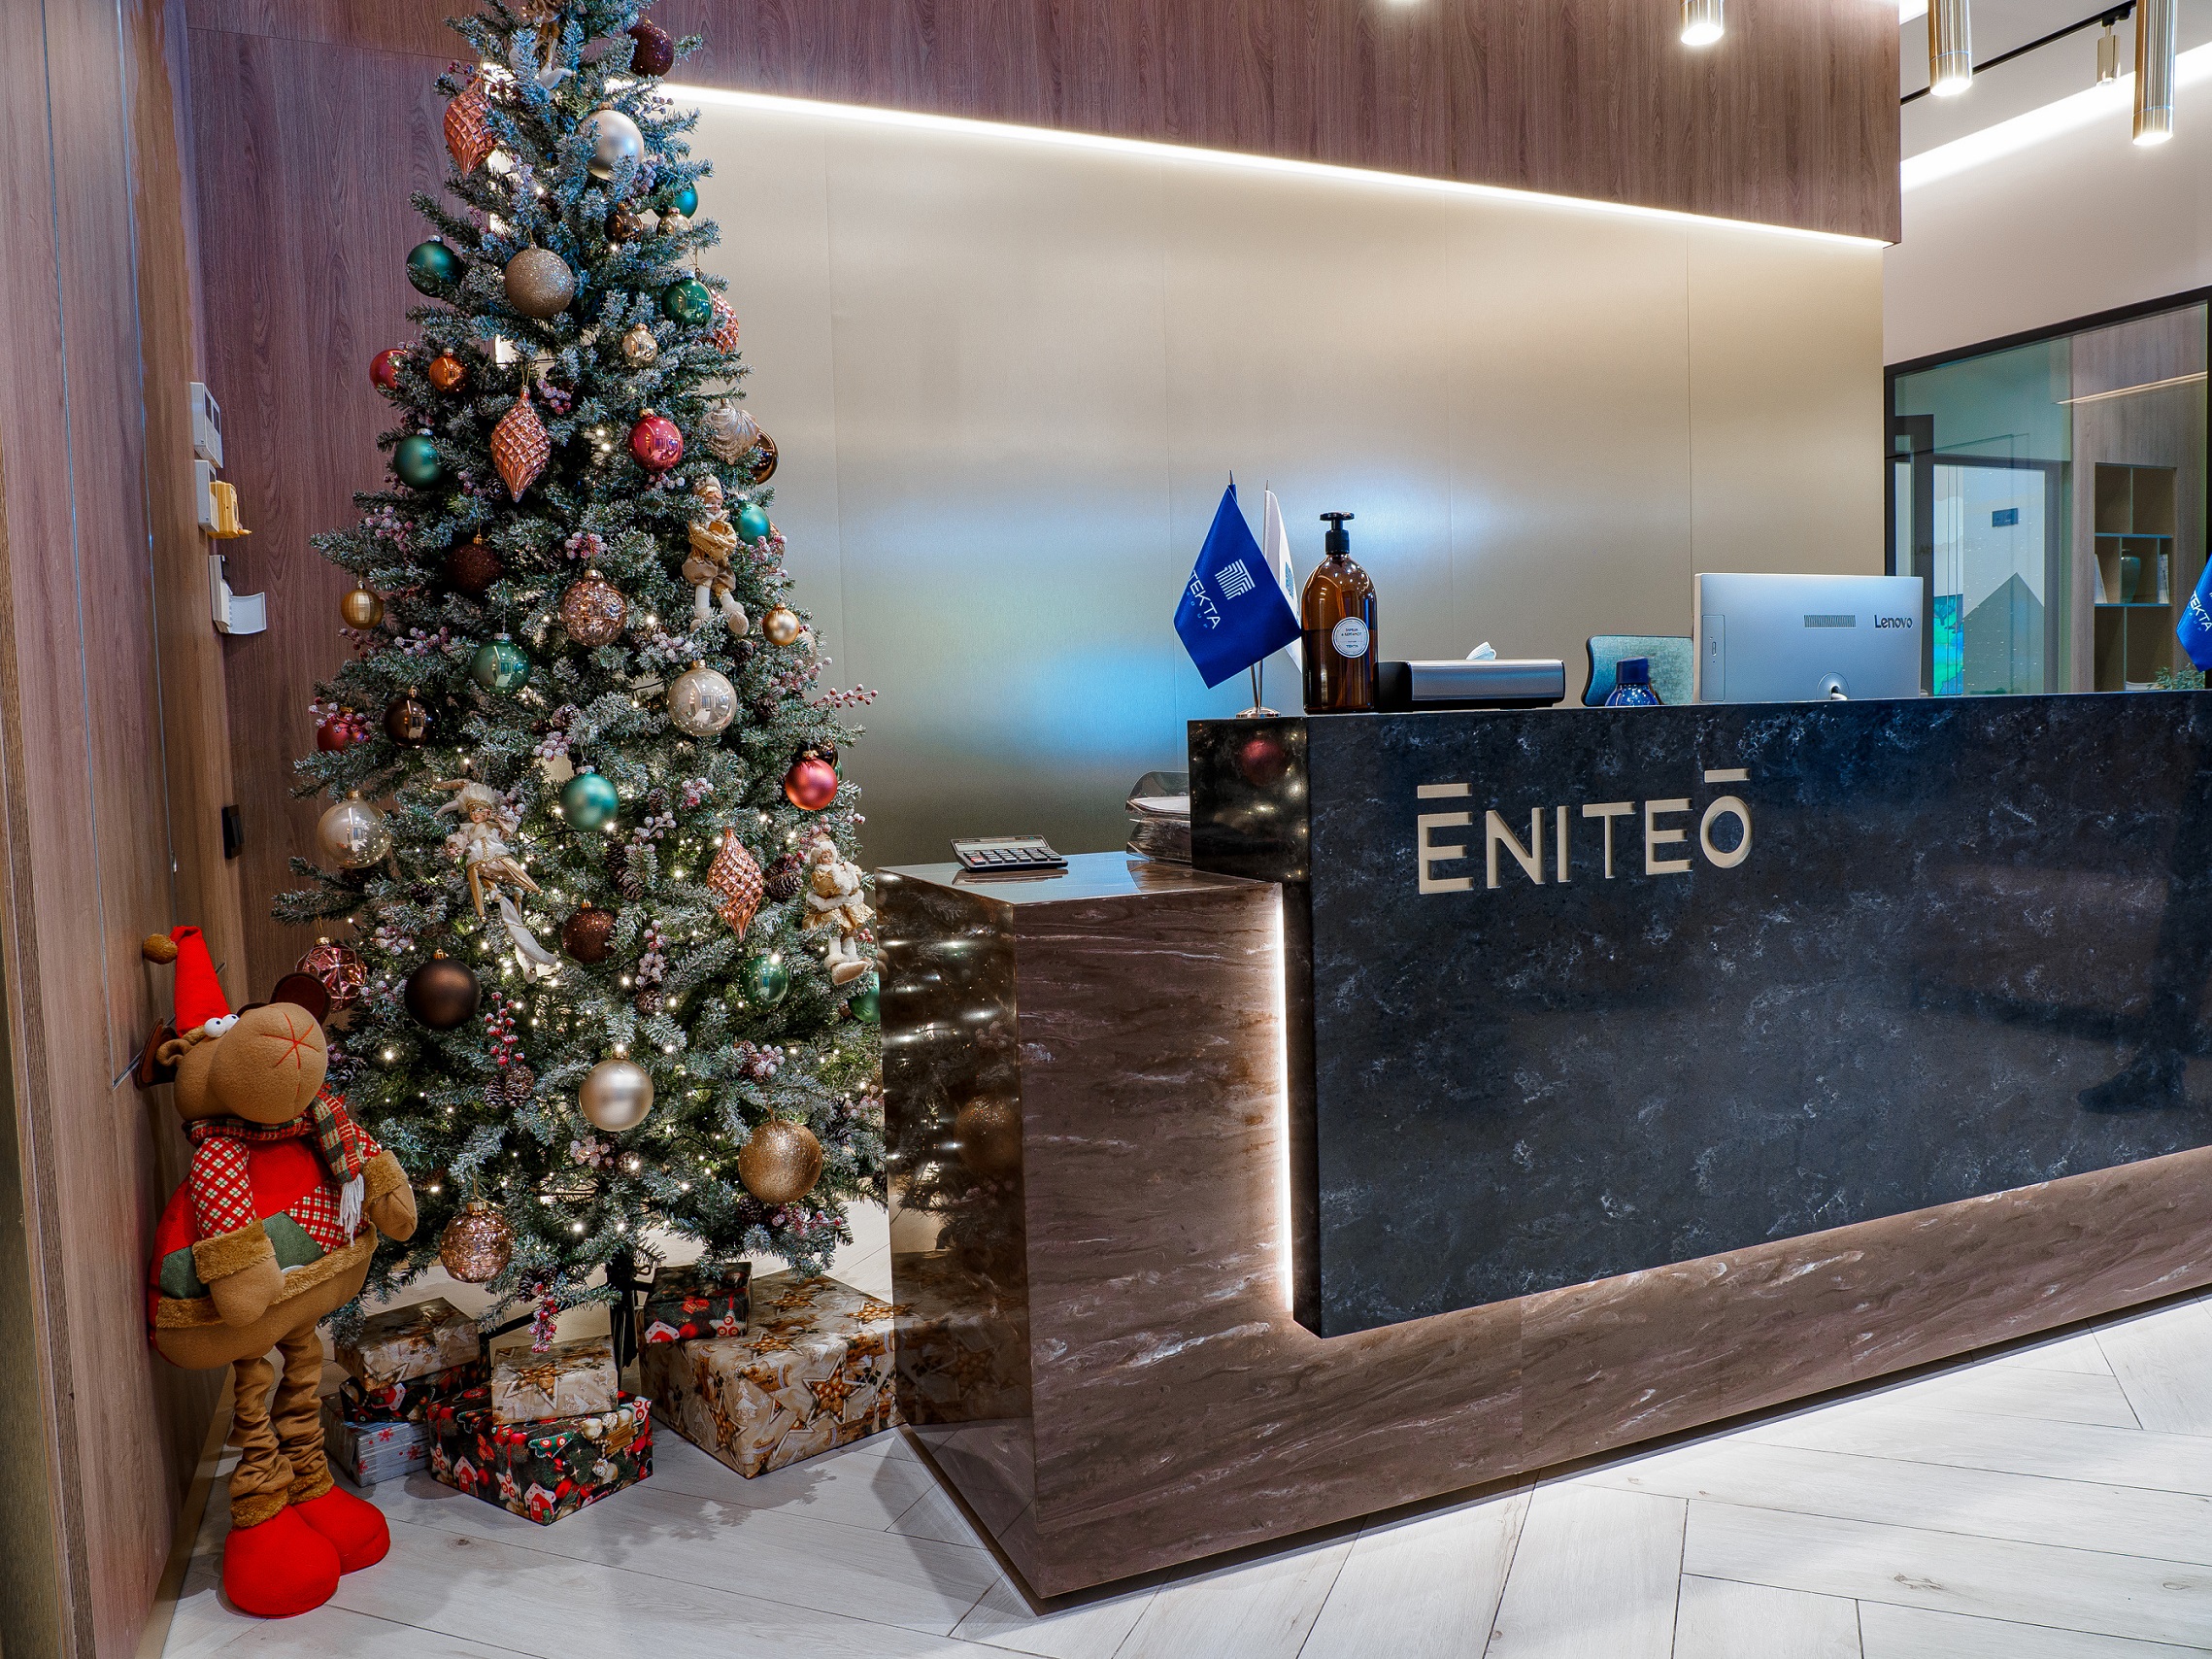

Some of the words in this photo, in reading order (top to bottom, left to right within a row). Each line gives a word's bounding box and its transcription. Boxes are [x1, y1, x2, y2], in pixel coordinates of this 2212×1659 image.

[1189, 569, 1222, 630] TEKTA
[2188, 589, 2212, 632] TEKTA
[1873, 614, 1914, 629] Lenovo
